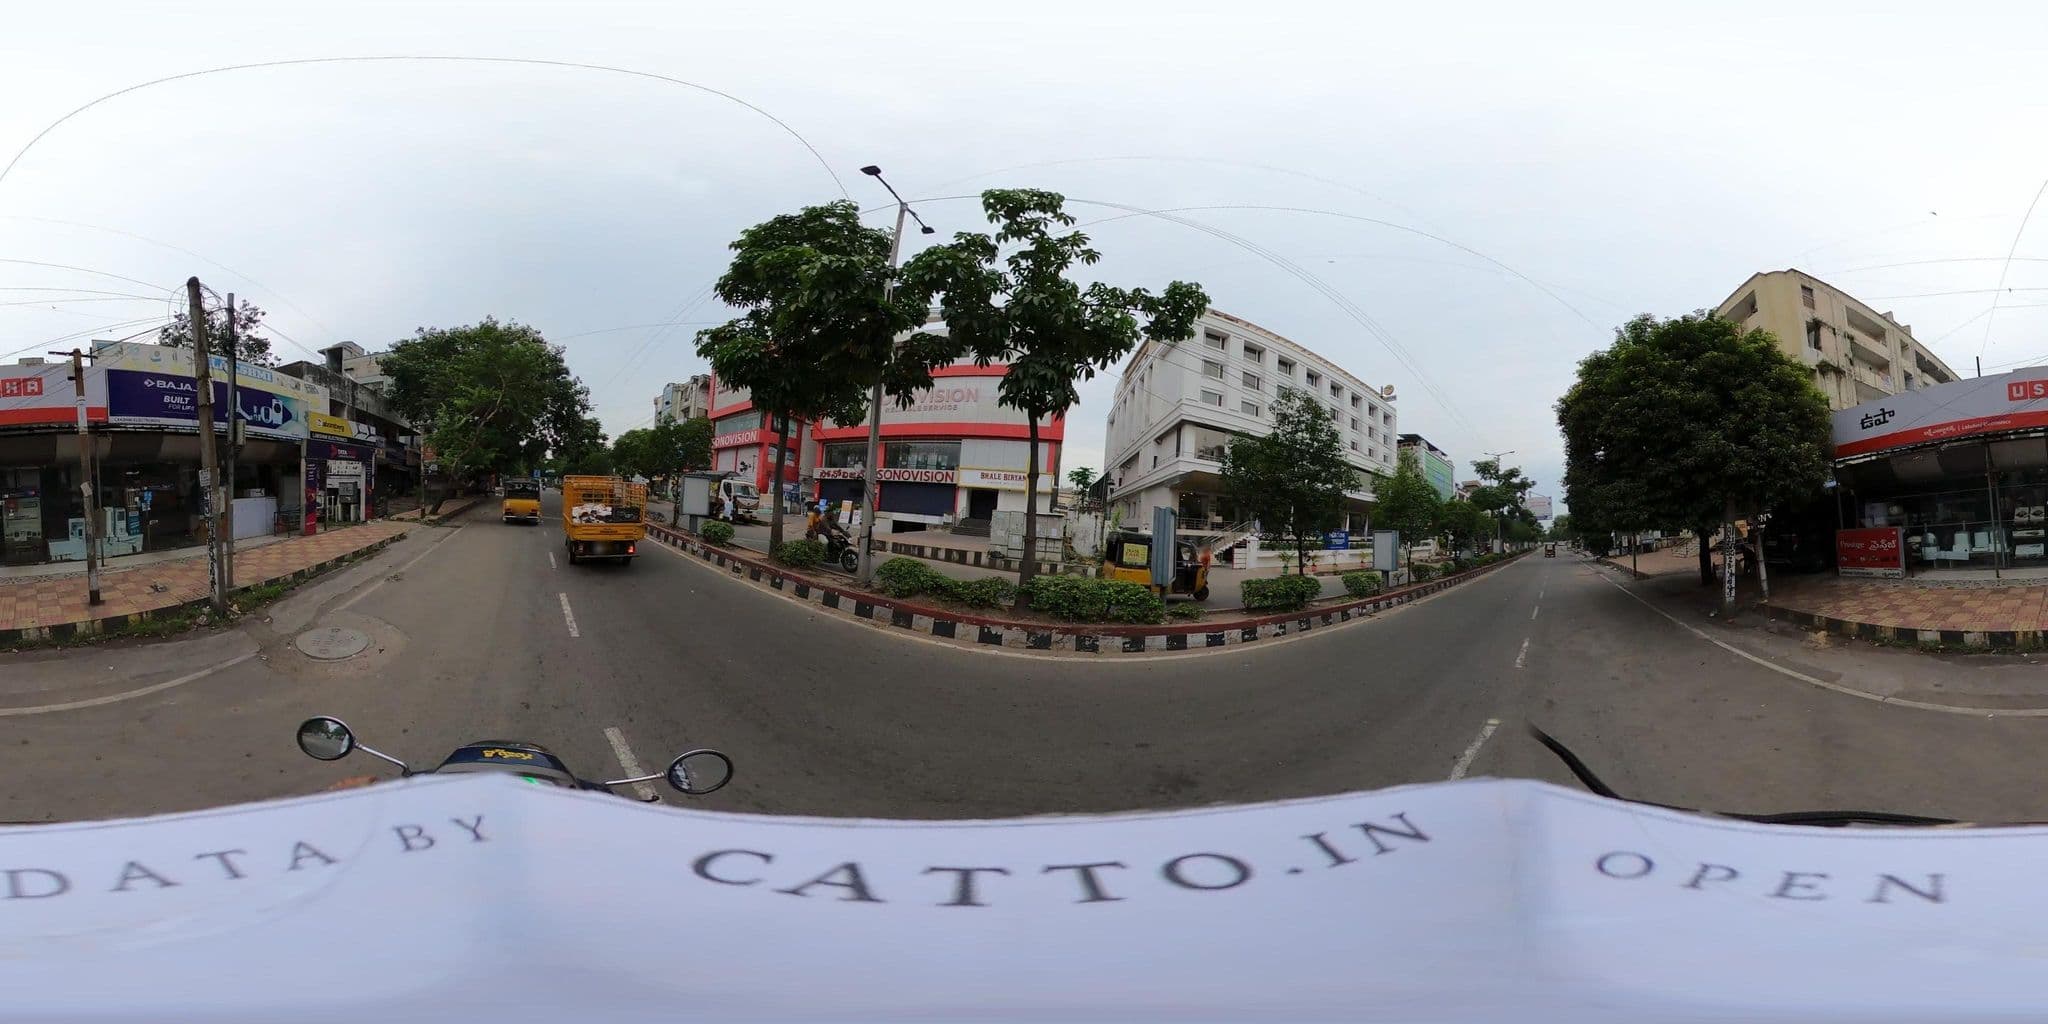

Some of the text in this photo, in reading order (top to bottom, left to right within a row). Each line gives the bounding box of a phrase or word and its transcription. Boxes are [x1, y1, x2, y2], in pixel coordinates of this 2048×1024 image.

[156, 380, 198, 392] BAJA
[163, 395, 190, 404] BUILT
[711, 431, 757, 449] SONOVISION
[876, 469, 954, 483] SONOVISION
[980, 472, 1001, 480] BHALE
[2, 811, 1432, 907] DATA BY CATTO.IN
[1596, 850, 1949, 905] OPEN
